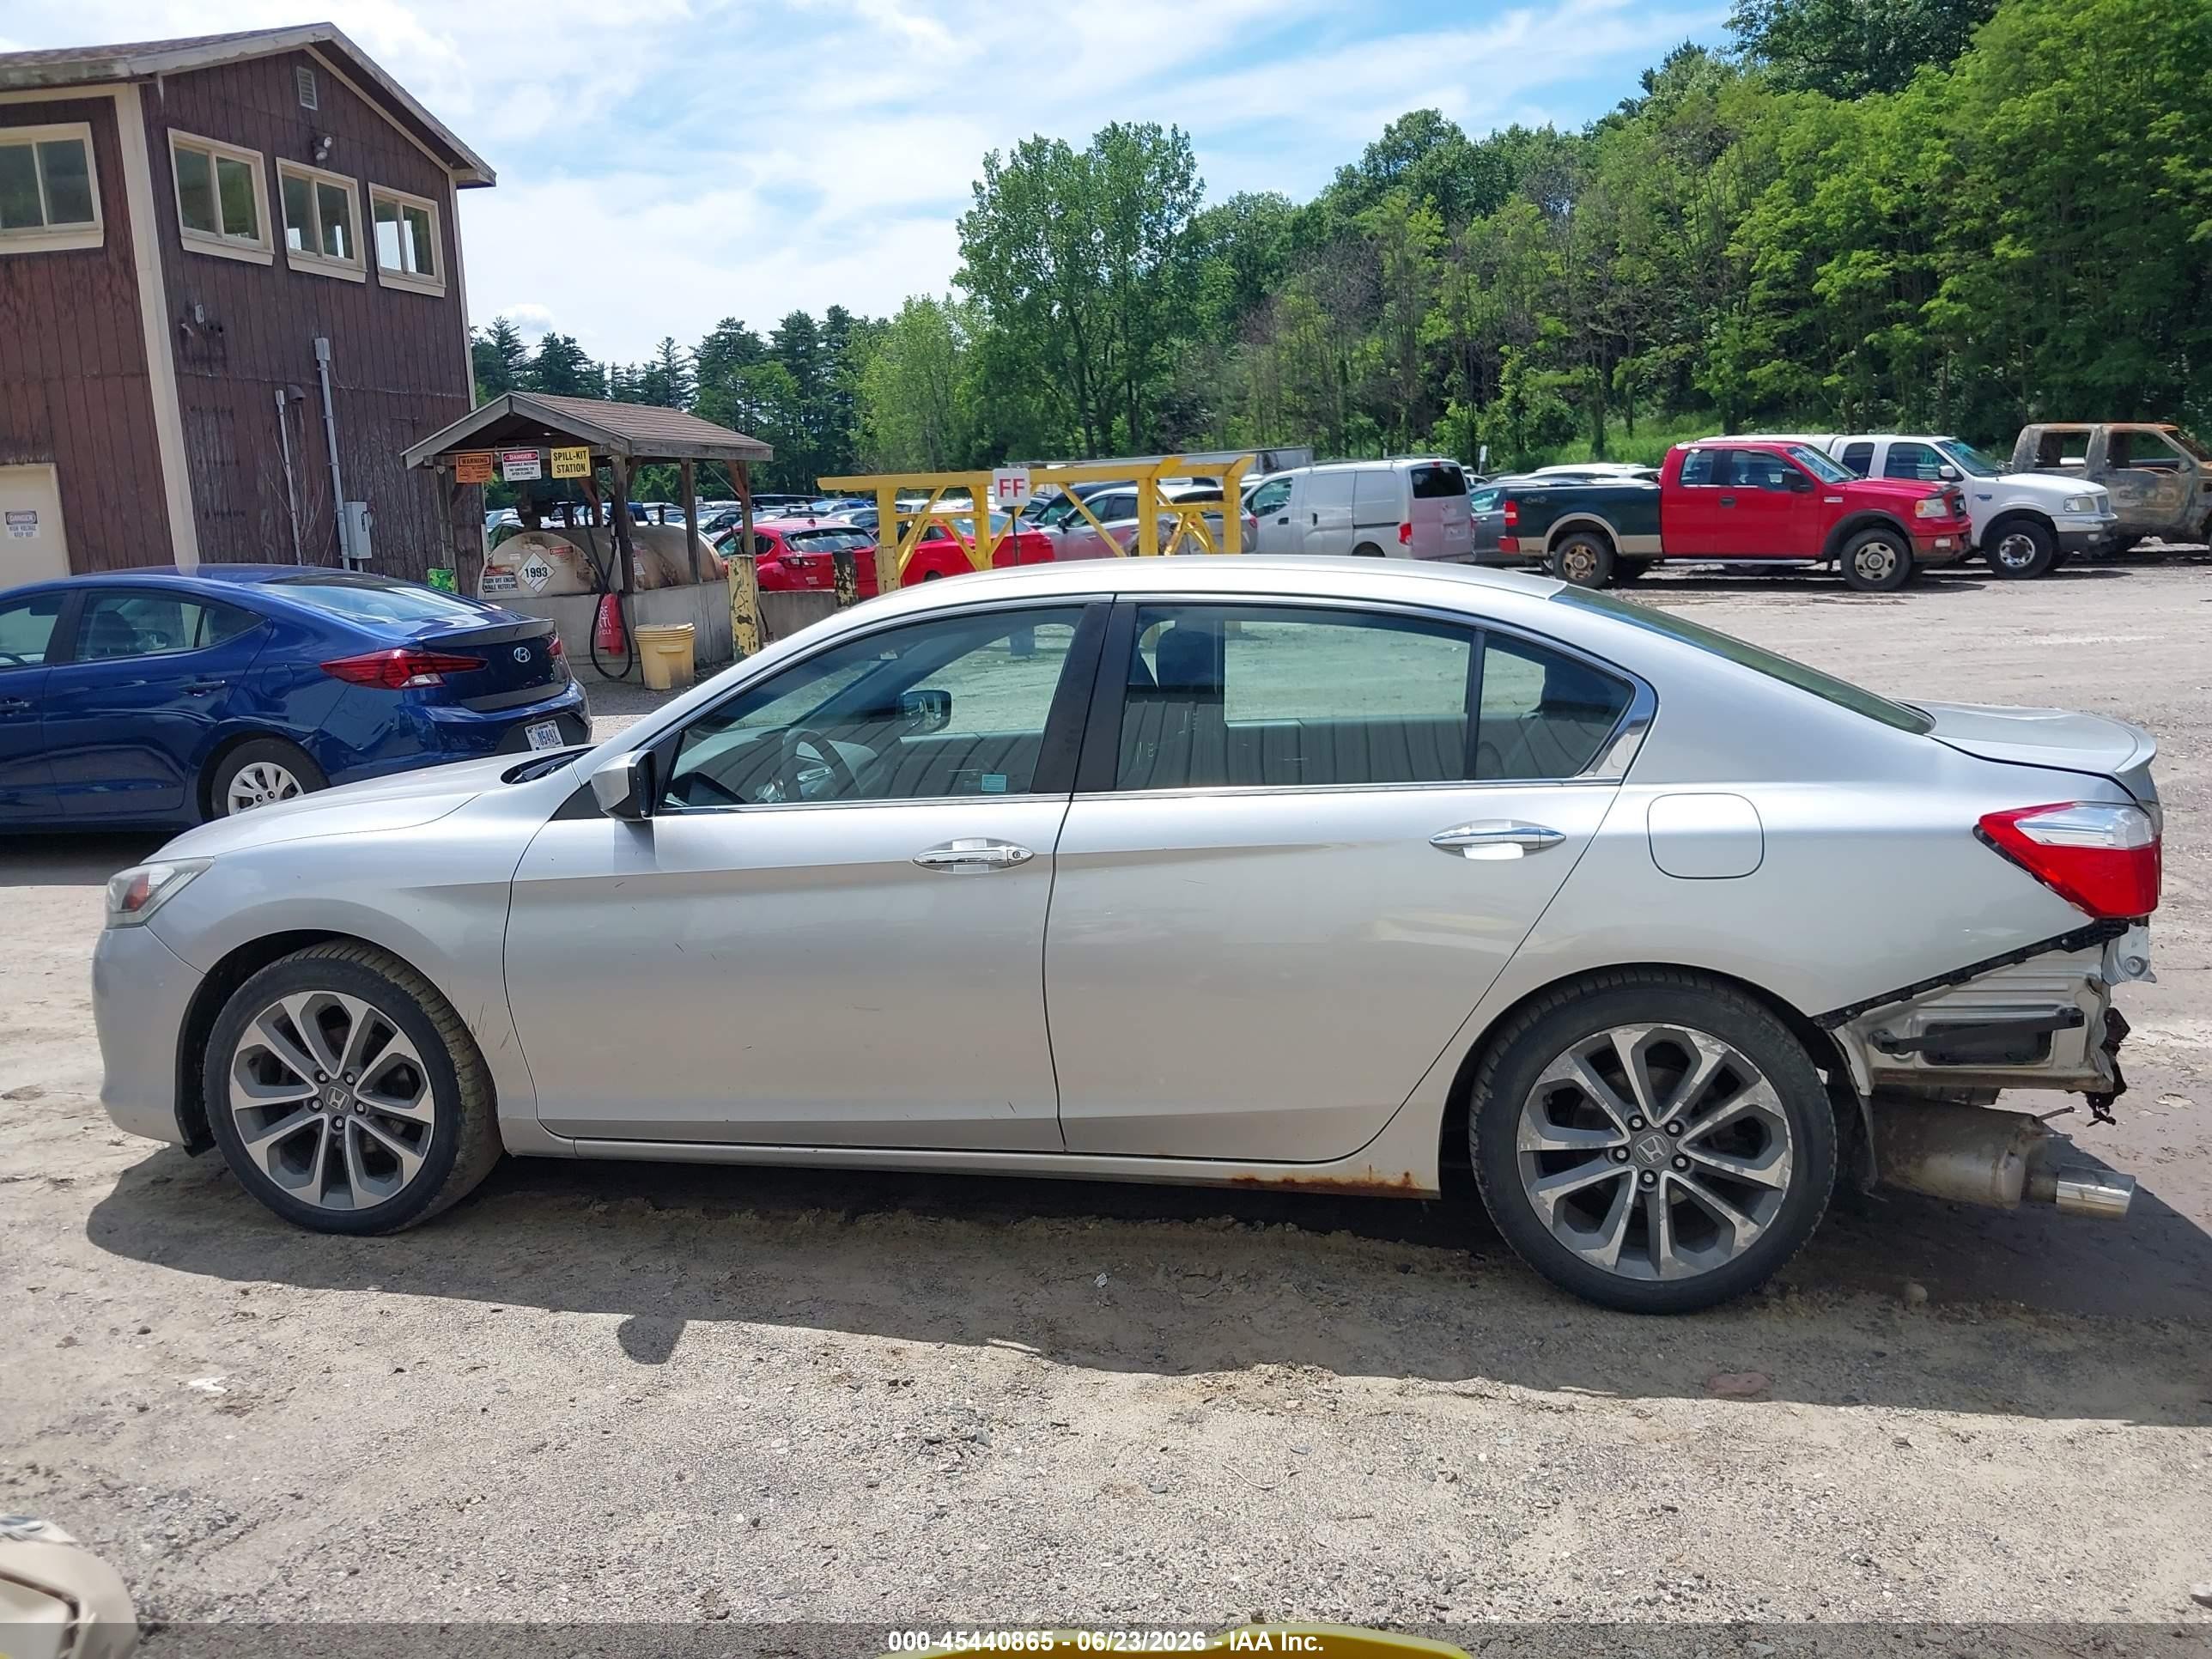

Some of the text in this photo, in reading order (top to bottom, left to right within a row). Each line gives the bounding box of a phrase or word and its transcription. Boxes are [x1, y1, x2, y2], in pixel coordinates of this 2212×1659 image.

[553, 450, 586, 461] SPILL-KIT
[556, 463, 586, 473] STATION
[999, 478, 1025, 498] FF
[525, 567, 548, 578] 1993
